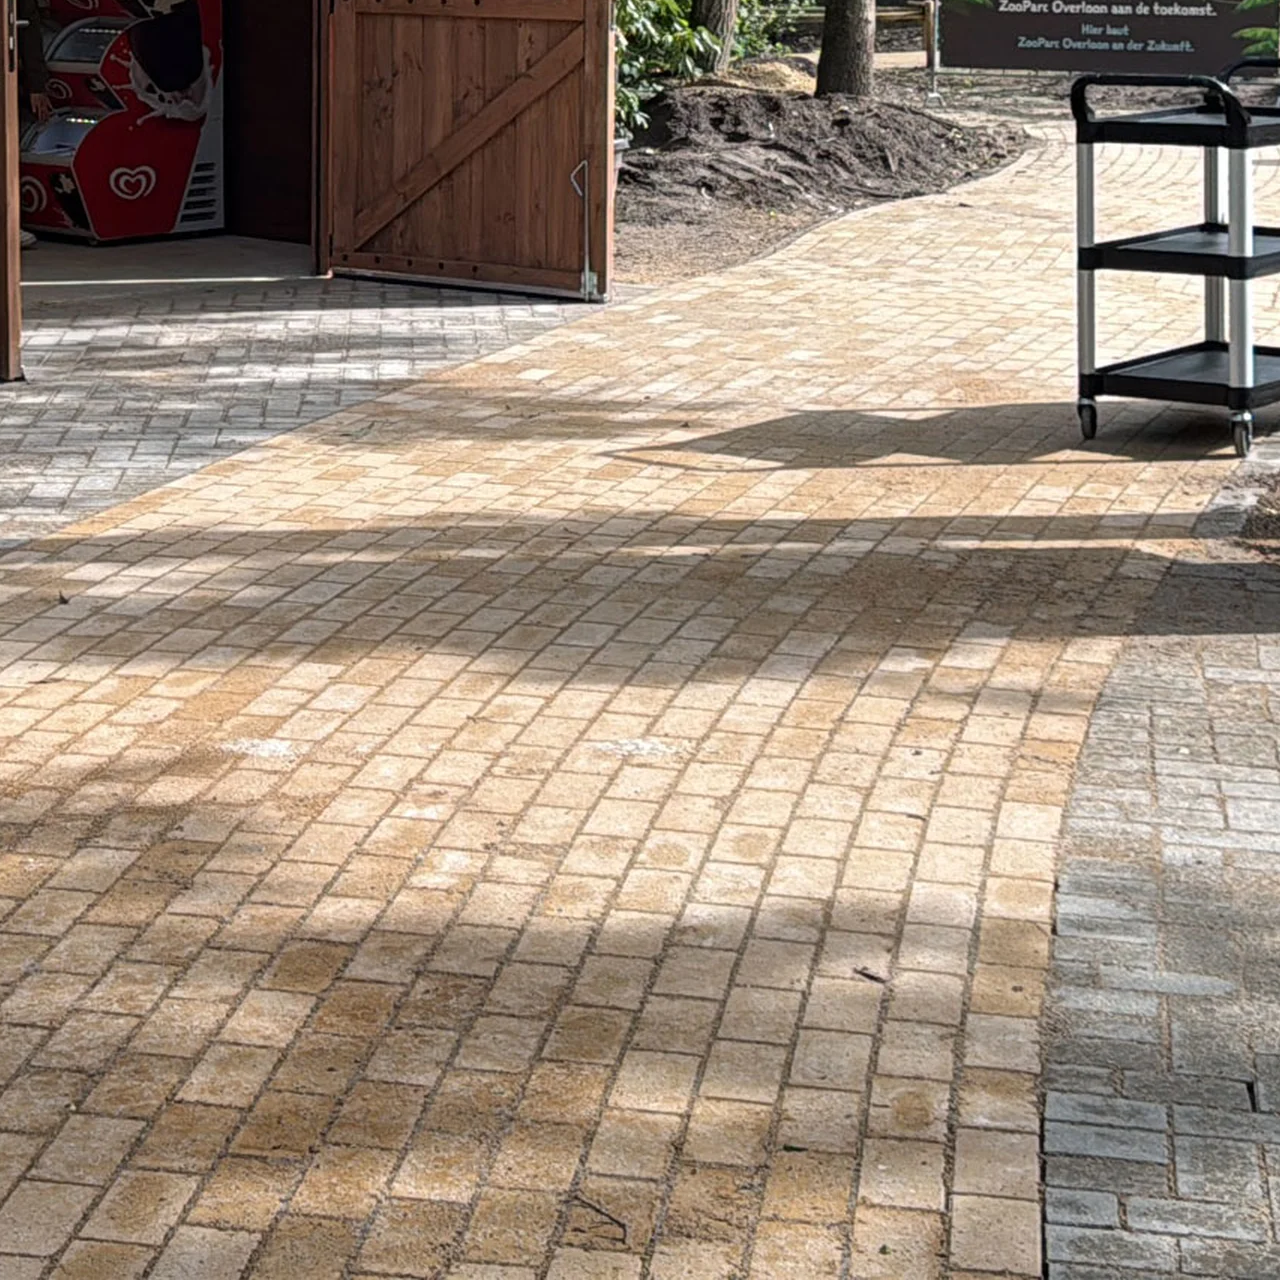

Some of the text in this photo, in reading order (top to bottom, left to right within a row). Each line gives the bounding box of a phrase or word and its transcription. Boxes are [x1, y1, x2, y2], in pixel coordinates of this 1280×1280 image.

[998, 0, 1217, 16] ZooParc Overloon aan de toekomst.
[1081, 23, 1103, 35] Hier
[1017, 36, 1195, 52] ZooParc Overloon an der Zukunft.
